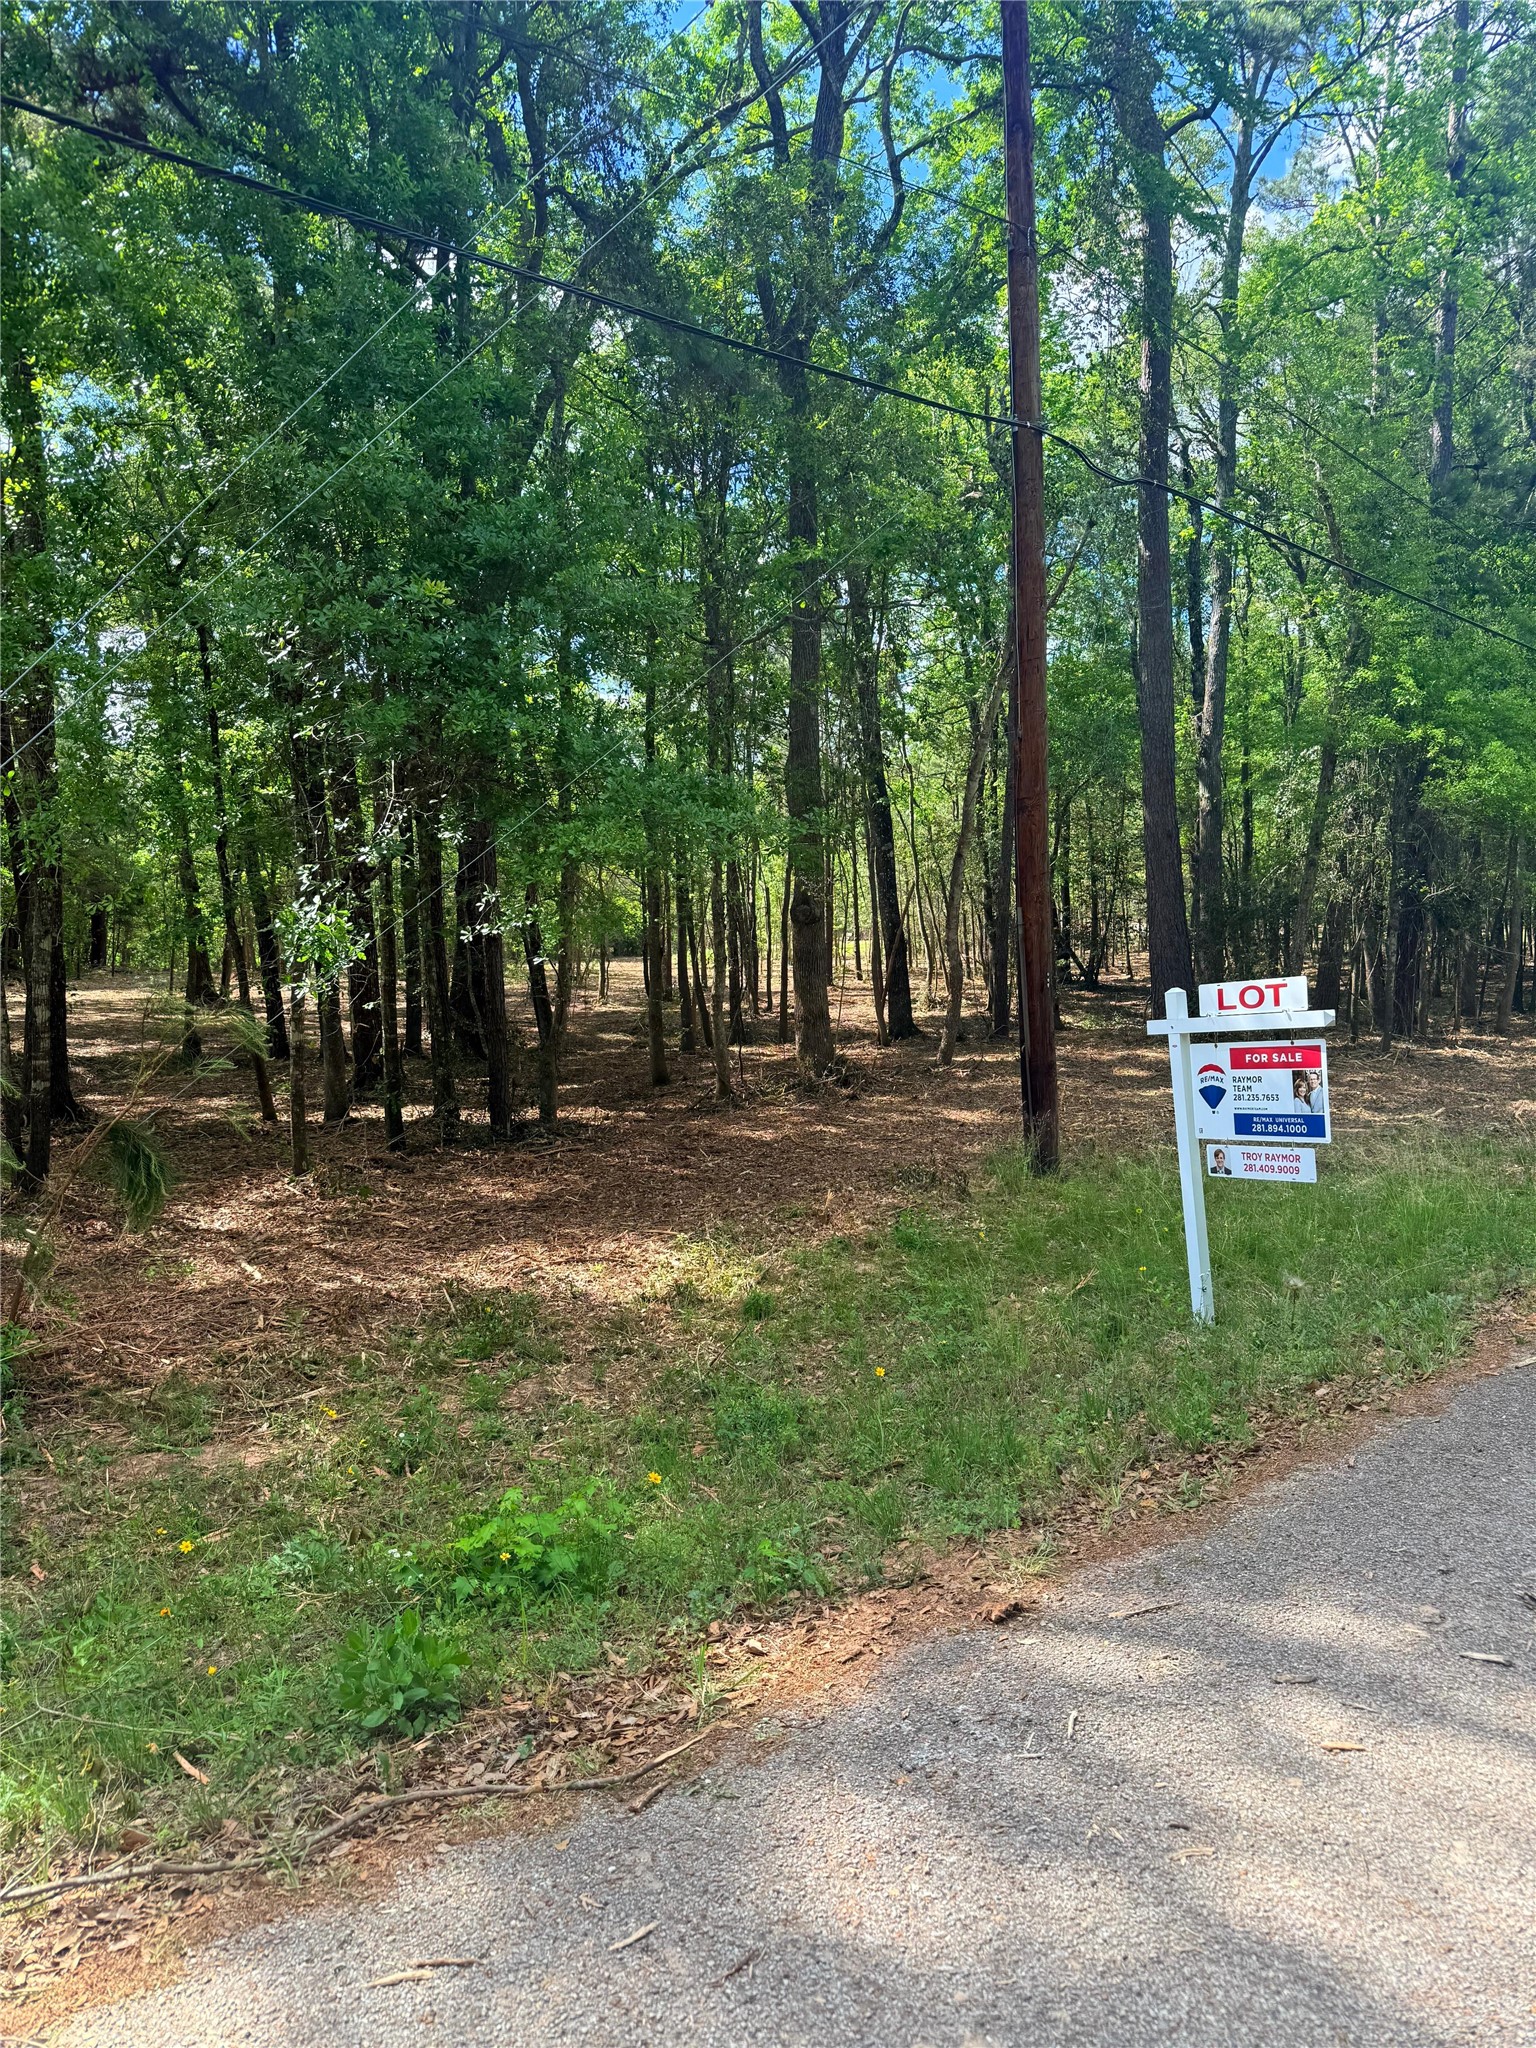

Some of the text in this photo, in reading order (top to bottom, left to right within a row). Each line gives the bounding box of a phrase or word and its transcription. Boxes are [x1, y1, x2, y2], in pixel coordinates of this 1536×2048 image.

[1217, 983, 1288, 1011] LOT
[1245, 1052, 1303, 1063] FOR SALE
[1200, 1075, 1225, 1084] RE/MAX
[1252, 1124, 1308, 1134] 281.894.1000
[1241, 1152, 1301, 1163] TROY RAYMOR
[1243, 1163, 1300, 1175] 281.409.9009
